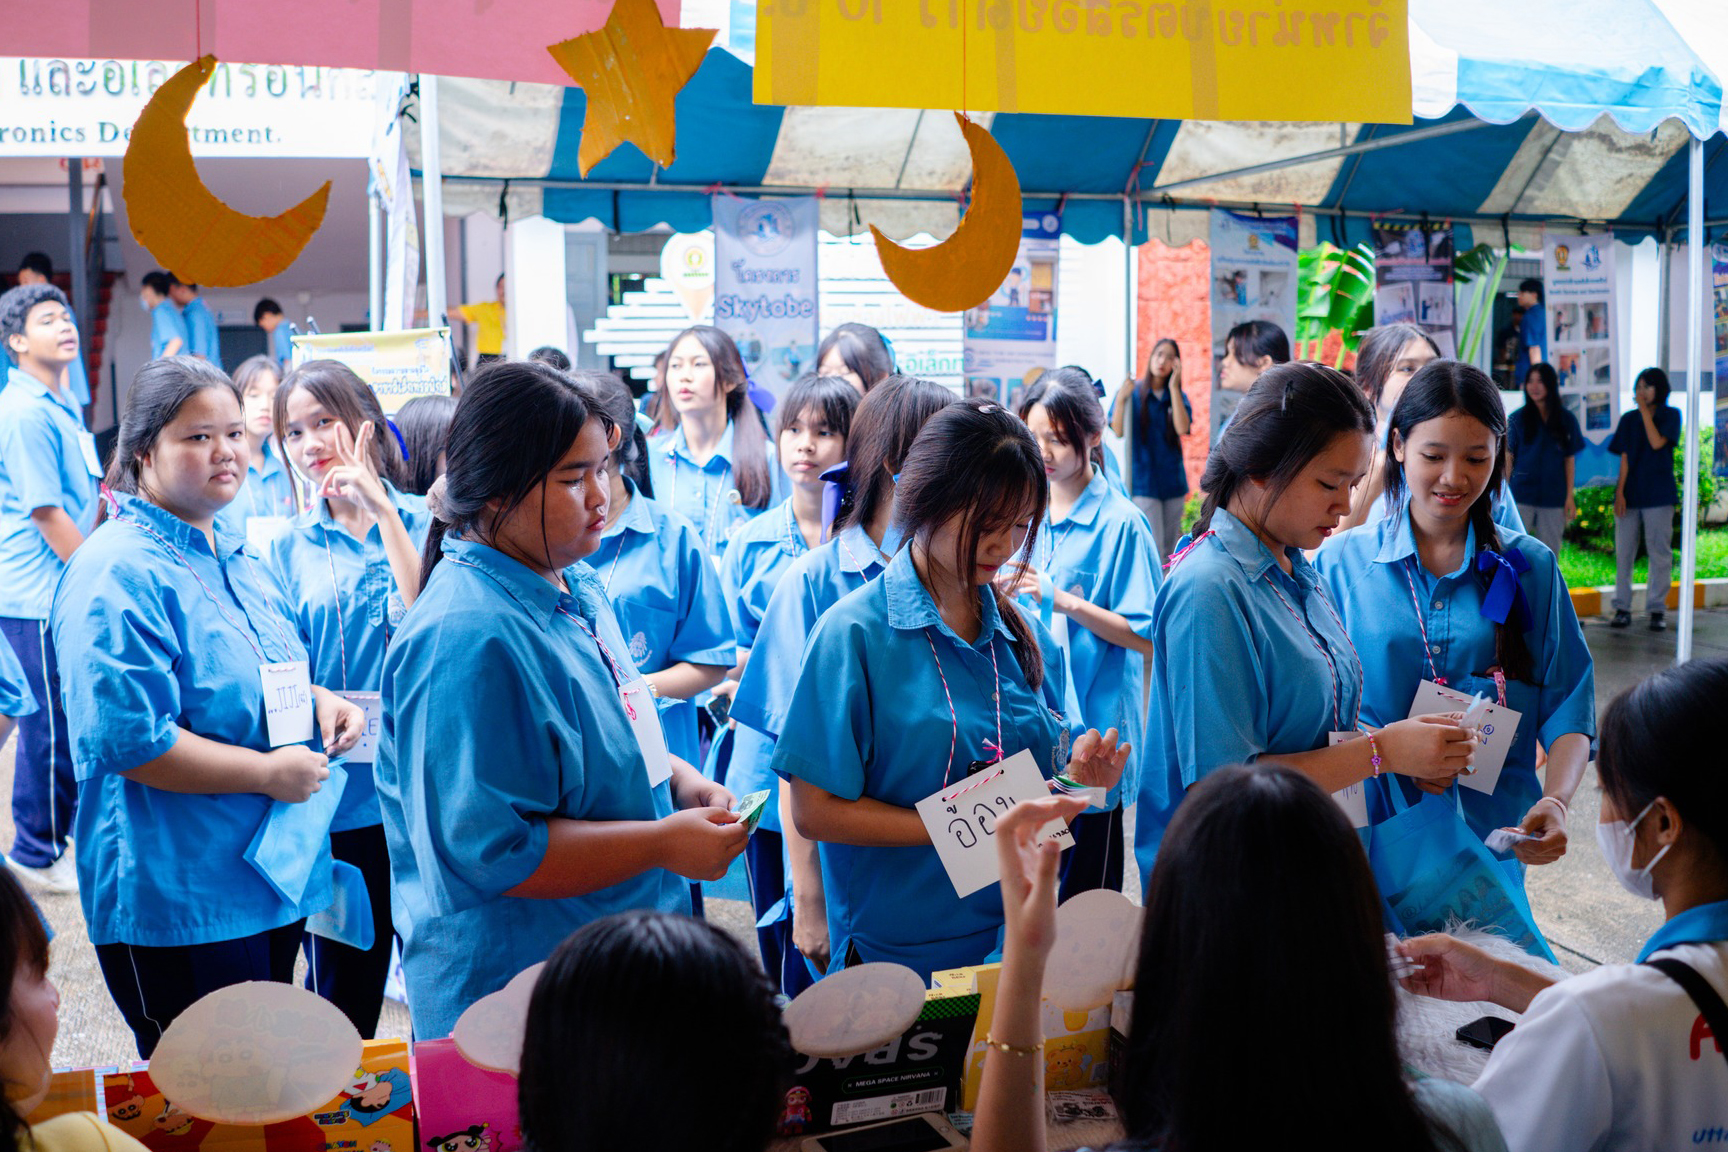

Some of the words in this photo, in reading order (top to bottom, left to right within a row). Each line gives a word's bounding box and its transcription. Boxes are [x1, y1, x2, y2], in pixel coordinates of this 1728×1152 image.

[98, 121, 282, 143] Detment.
[716, 293, 815, 324] Skytobe
[855, 1078, 877, 1088] MEGA
[877, 1075, 899, 1085] SPACE
[900, 1071, 931, 1082] NIRVANA
